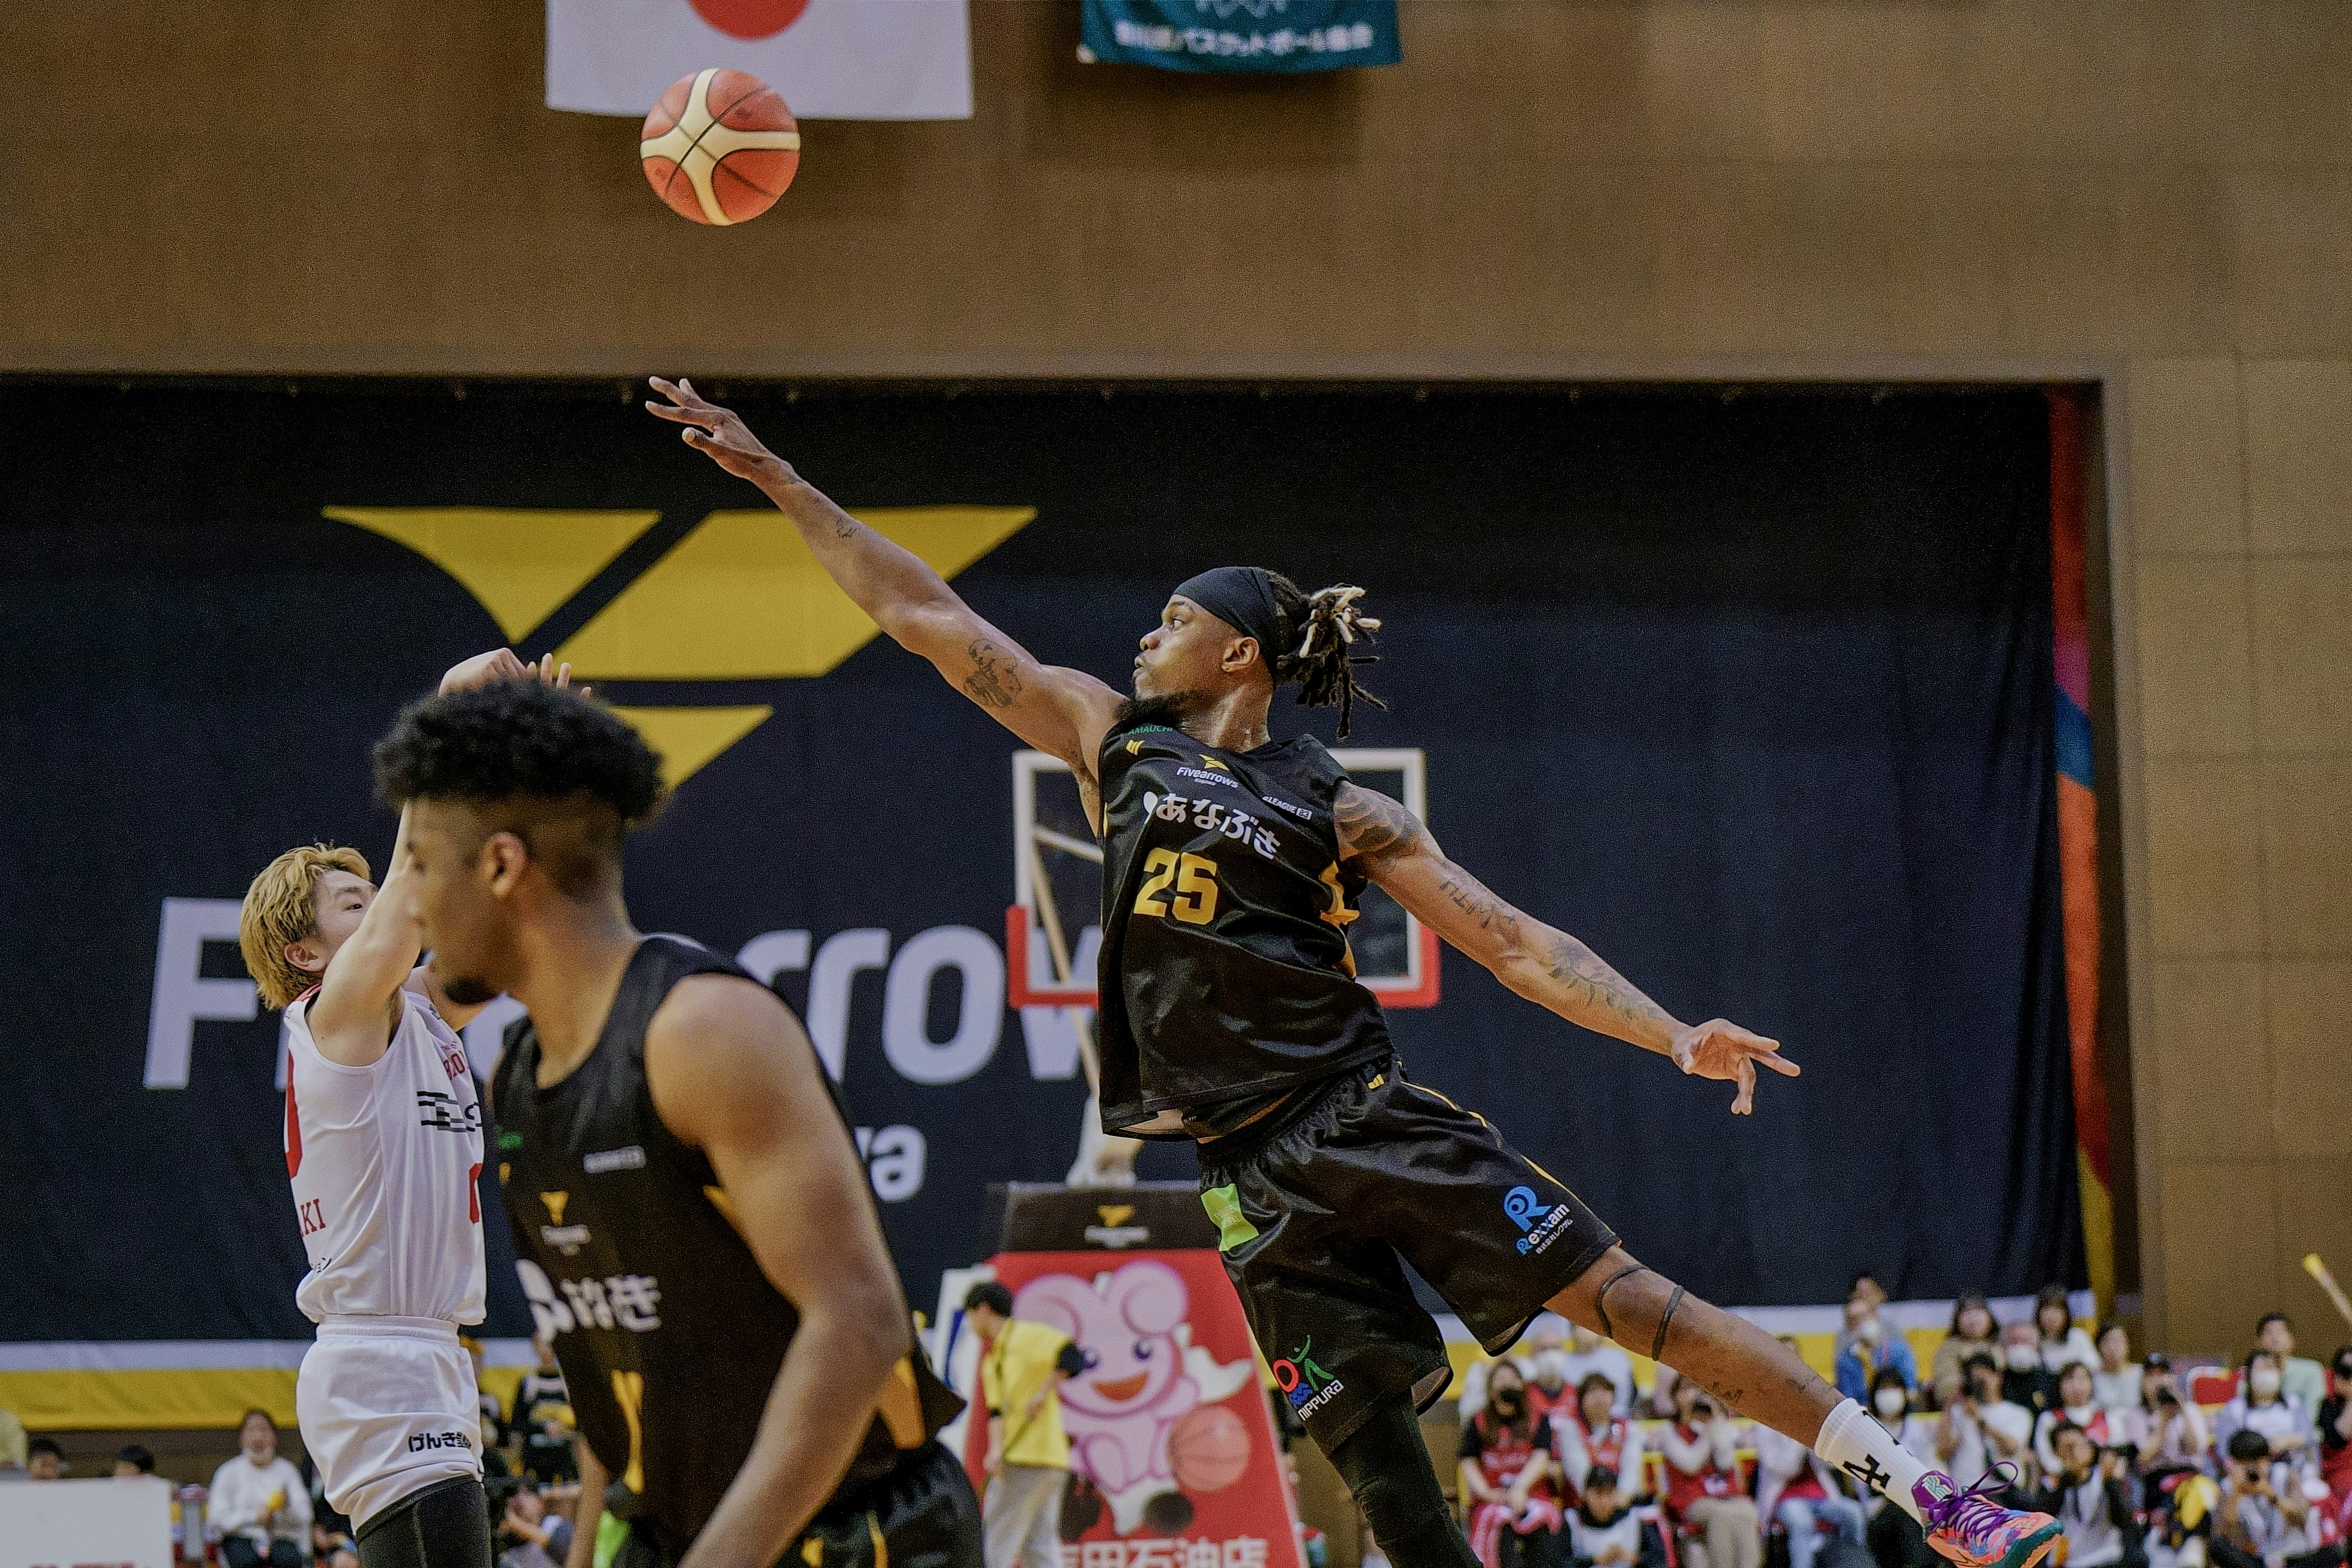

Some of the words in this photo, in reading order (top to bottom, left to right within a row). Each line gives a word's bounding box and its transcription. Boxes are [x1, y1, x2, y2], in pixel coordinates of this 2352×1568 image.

[1176, 767, 1239, 788] Fivearrows
[1156, 793, 1281, 859] あなぶき
[1134, 847, 1218, 925] 25
[1516, 1203, 1570, 1255] Rexxam
